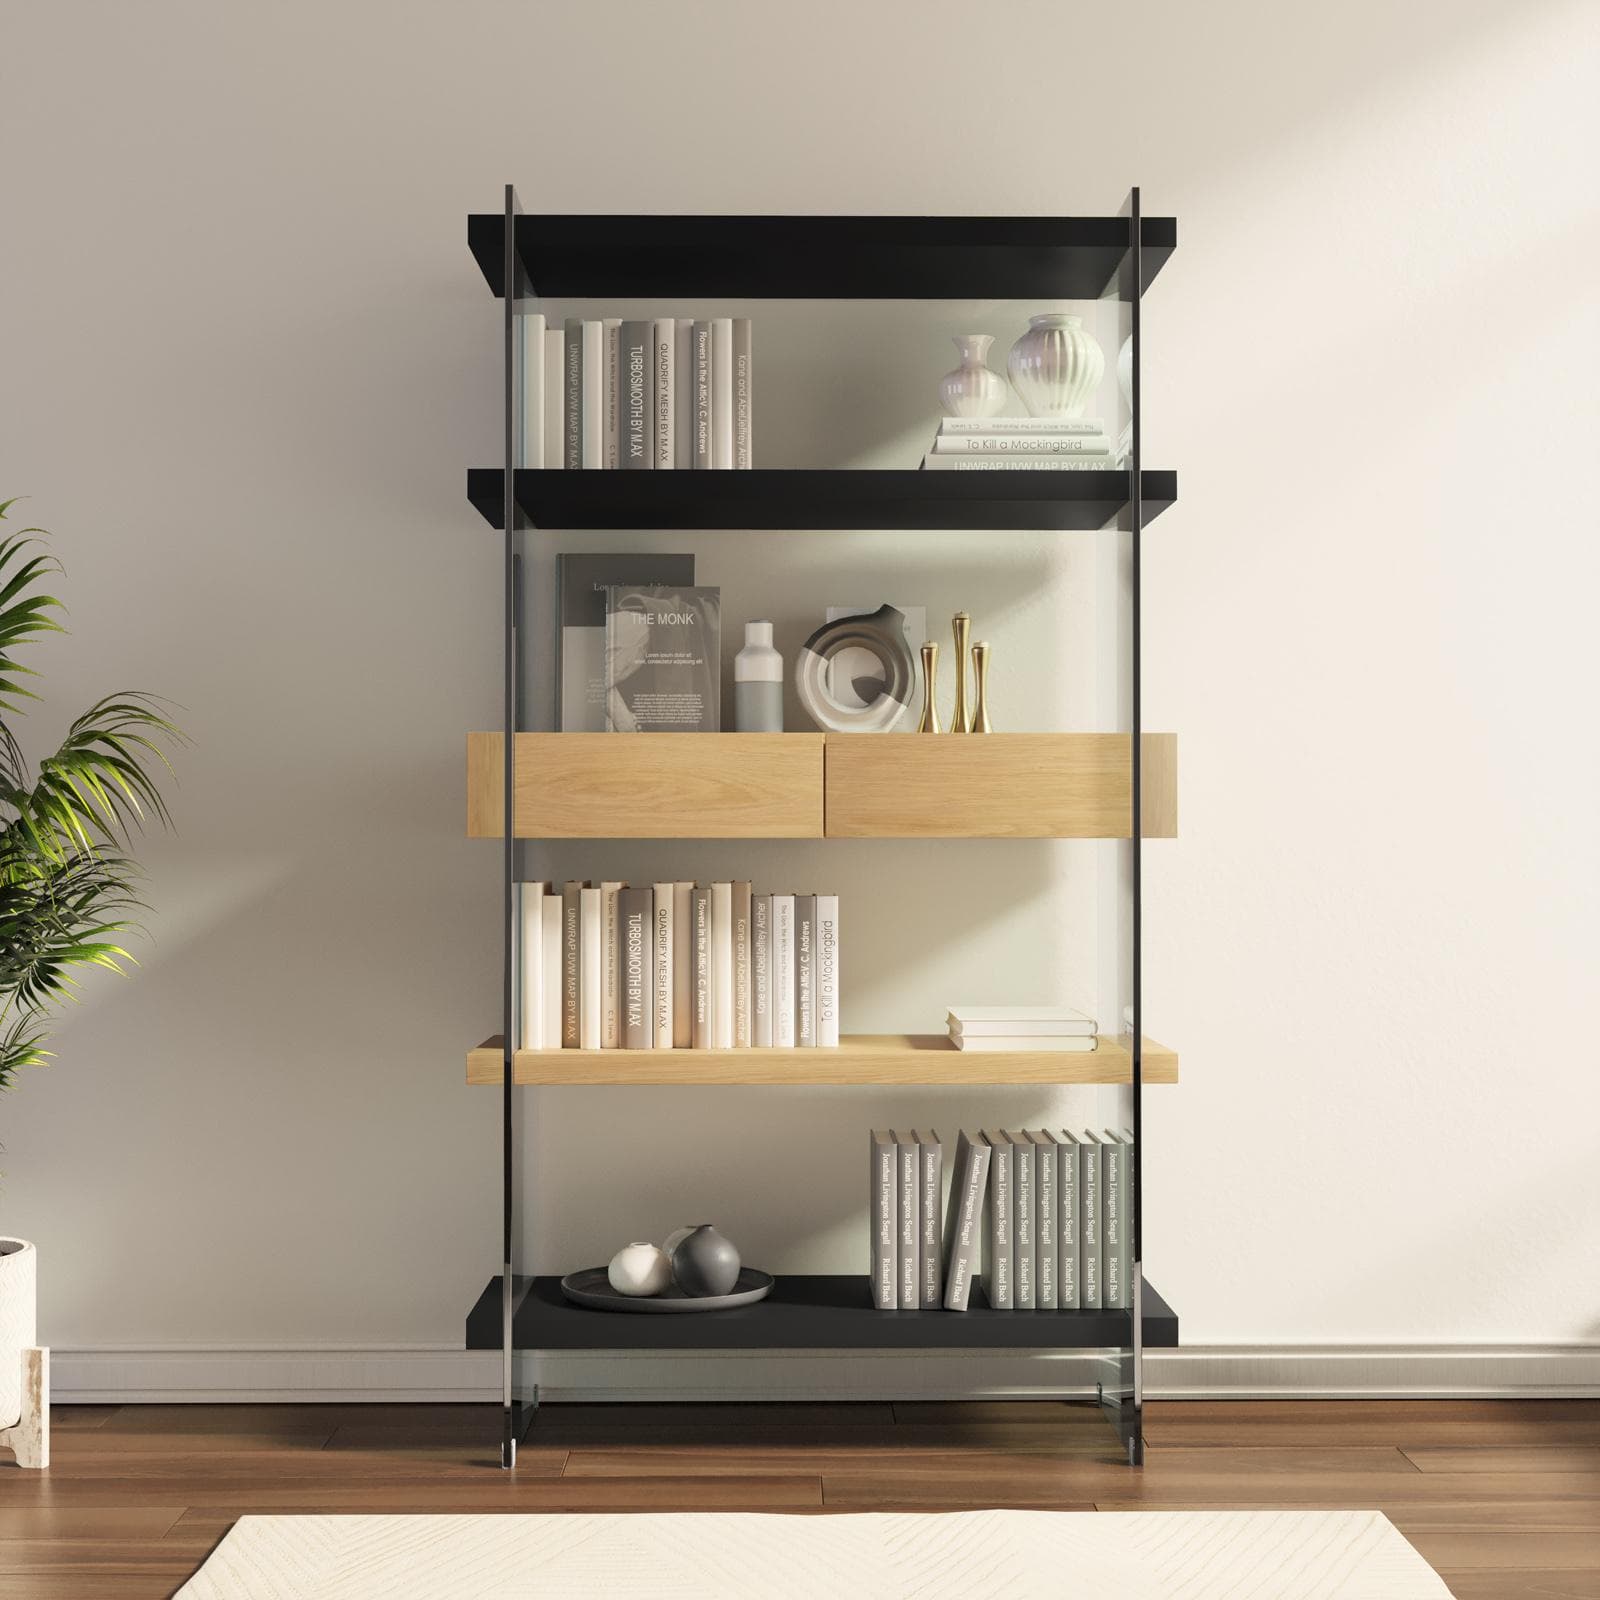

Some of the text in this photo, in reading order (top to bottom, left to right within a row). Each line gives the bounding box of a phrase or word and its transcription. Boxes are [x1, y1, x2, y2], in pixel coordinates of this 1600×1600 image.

[699, 331, 707, 359] Flowers
[699, 369, 707, 382] the
[630, 346, 643, 457] TURBOSMOOTH BY M.AX
[660, 343, 669, 461] QUADRIFY MESH BY M.AX
[699, 410, 707, 419] C.
[699, 421, 707, 454] Andrews
[966, 439, 979, 450] To
[982, 439, 996, 450] Kill
[1011, 439, 1082, 452] Mockingbird
[632, 613, 694, 624] THE MONK
[698, 899, 706, 928] Flowers
[698, 938, 706, 950] the
[821, 920, 836, 982] Mockingbird
[568, 908, 576, 1039] UNWRAP UVW MAP BY M.AX
[628, 914, 641, 1026] TURBOSMOOTH BY M.AX
[659, 909, 667, 1029] QUADRIFY MESH BY M.AX
[698, 979, 706, 989] C.
[698, 990, 706, 1023] Andrews
[821, 995, 833, 1008] Kill
[821, 1011, 833, 1022] To
[881, 1153, 891, 1244] Jonathan Livingston Seagull
[903, 1153, 912, 1244] Jonathan Livingston Seagull
[925, 1153, 934, 1244] Jonathan Livingston Seagull
[961, 1154, 982, 1246] Jonathan Livingston Seagull
[997, 1153, 1007, 1244] Jonathan Livingston Seagull
[1019, 1153, 1029, 1244] Jonathan Livingston Seagull
[1041, 1153, 1051, 1244] Jonathan Livingston Seagull
[1063, 1153, 1073, 1244] Jonathan Livingston Seagull
[1086, 1153, 1095, 1244] Jonathan Livingston Seagull
[1108, 1153, 1117, 1244] Jonathan Livingston Seagull
[883, 1258, 891, 1302] Richard Bach
[953, 1259, 967, 1303] Richard Bach
[999, 1258, 1007, 1302] Richard Bach
[1021, 1258, 1029, 1302] Richard Bach
[1043, 1258, 1051, 1302] Richard Bach
[1065, 1258, 1073, 1302] Richard Bach
